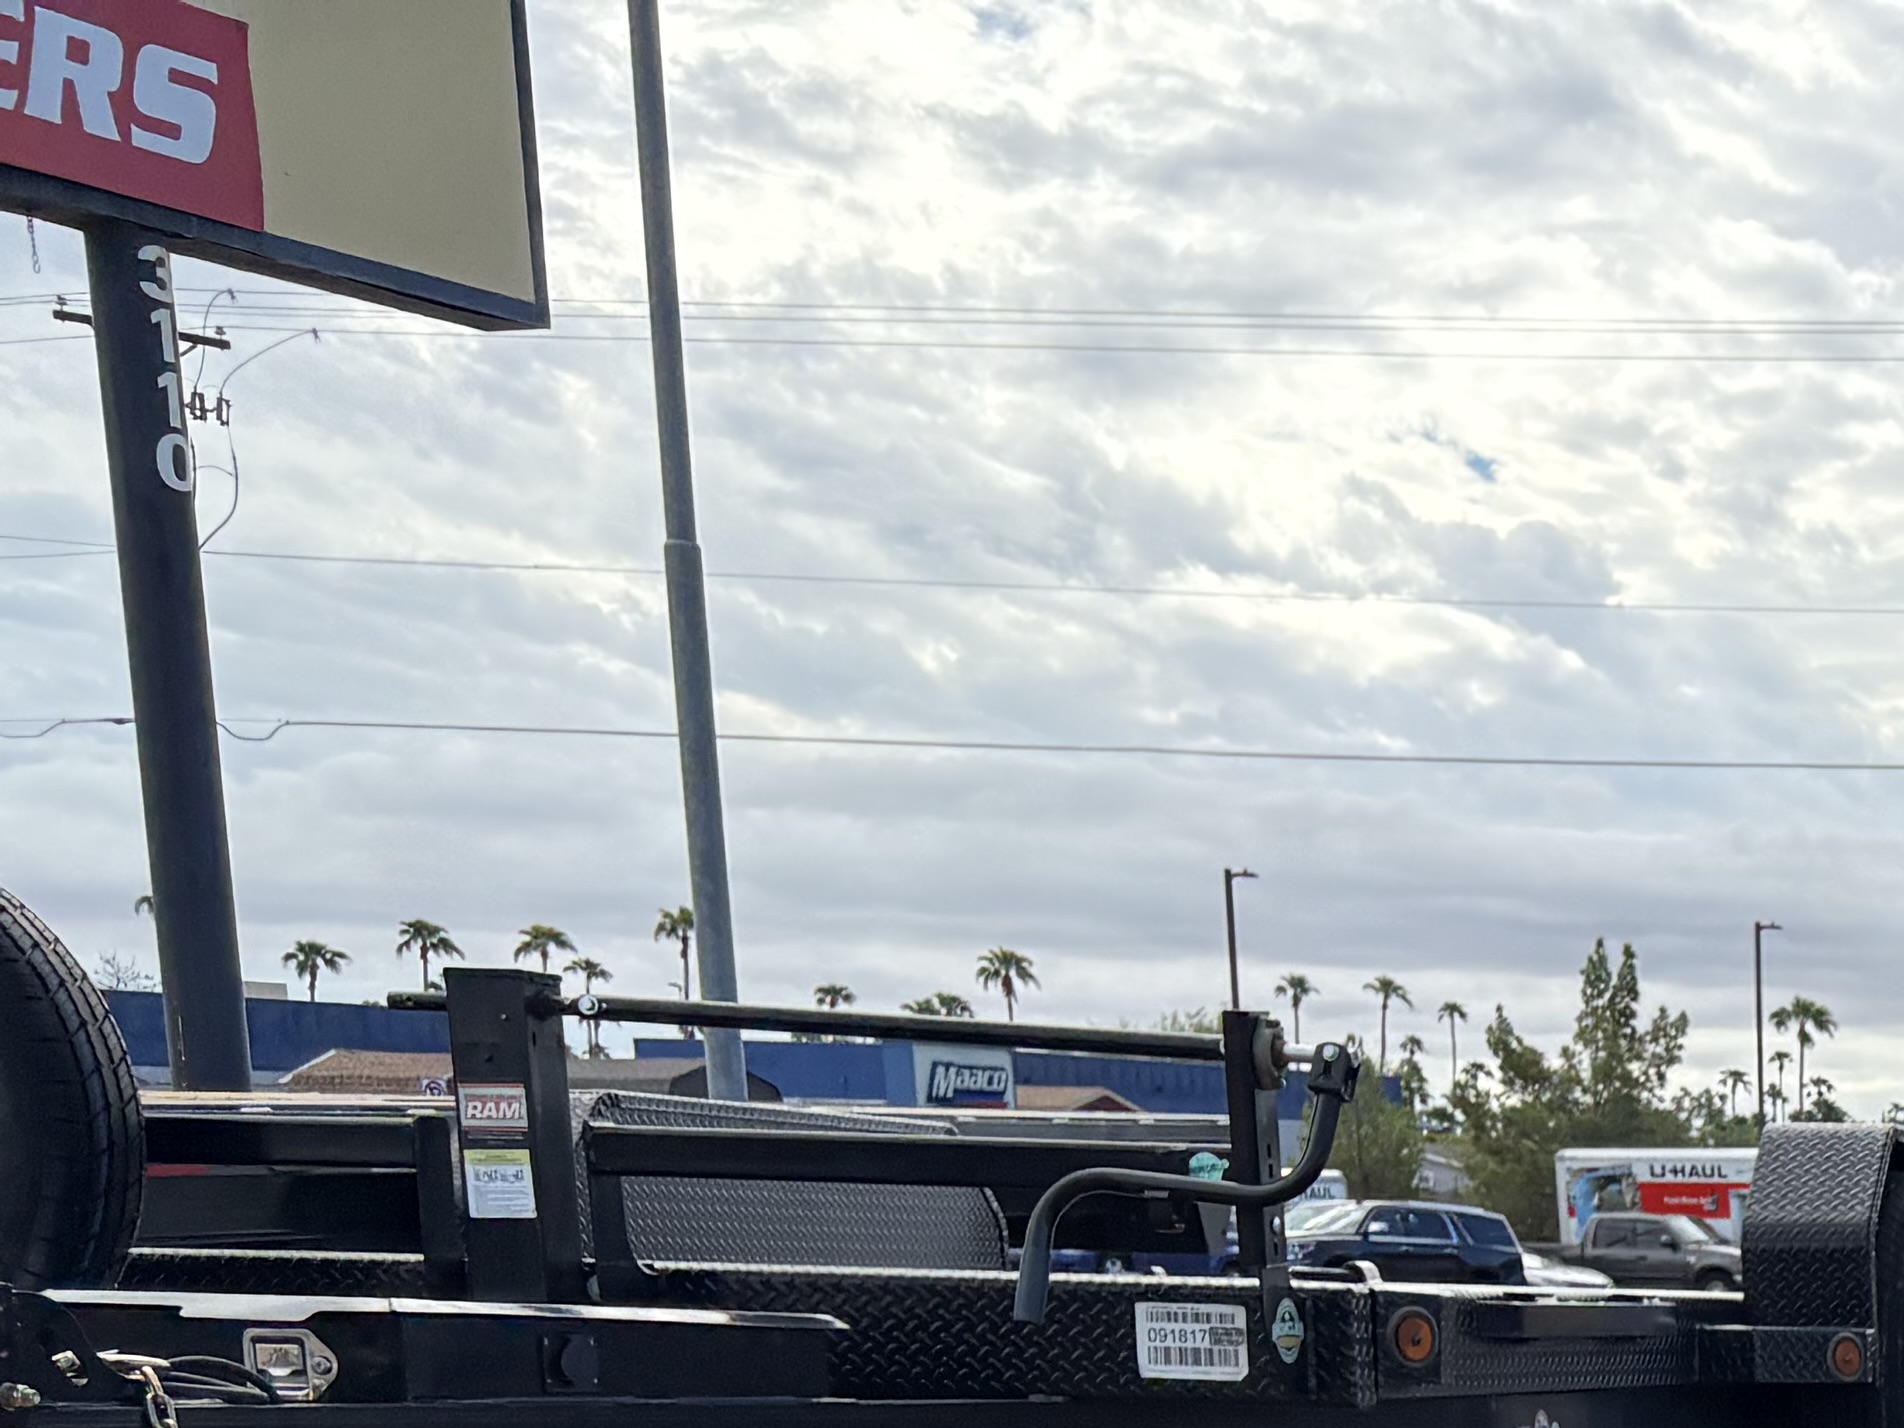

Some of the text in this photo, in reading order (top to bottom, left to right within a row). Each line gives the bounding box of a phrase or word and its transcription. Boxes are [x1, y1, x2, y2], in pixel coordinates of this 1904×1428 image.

[137, 245, 193, 492] 3110
[931, 1063, 1007, 1099] Maaco
[466, 1100, 521, 1120] RAM
[1148, 1327, 1208, 1345] 091817
